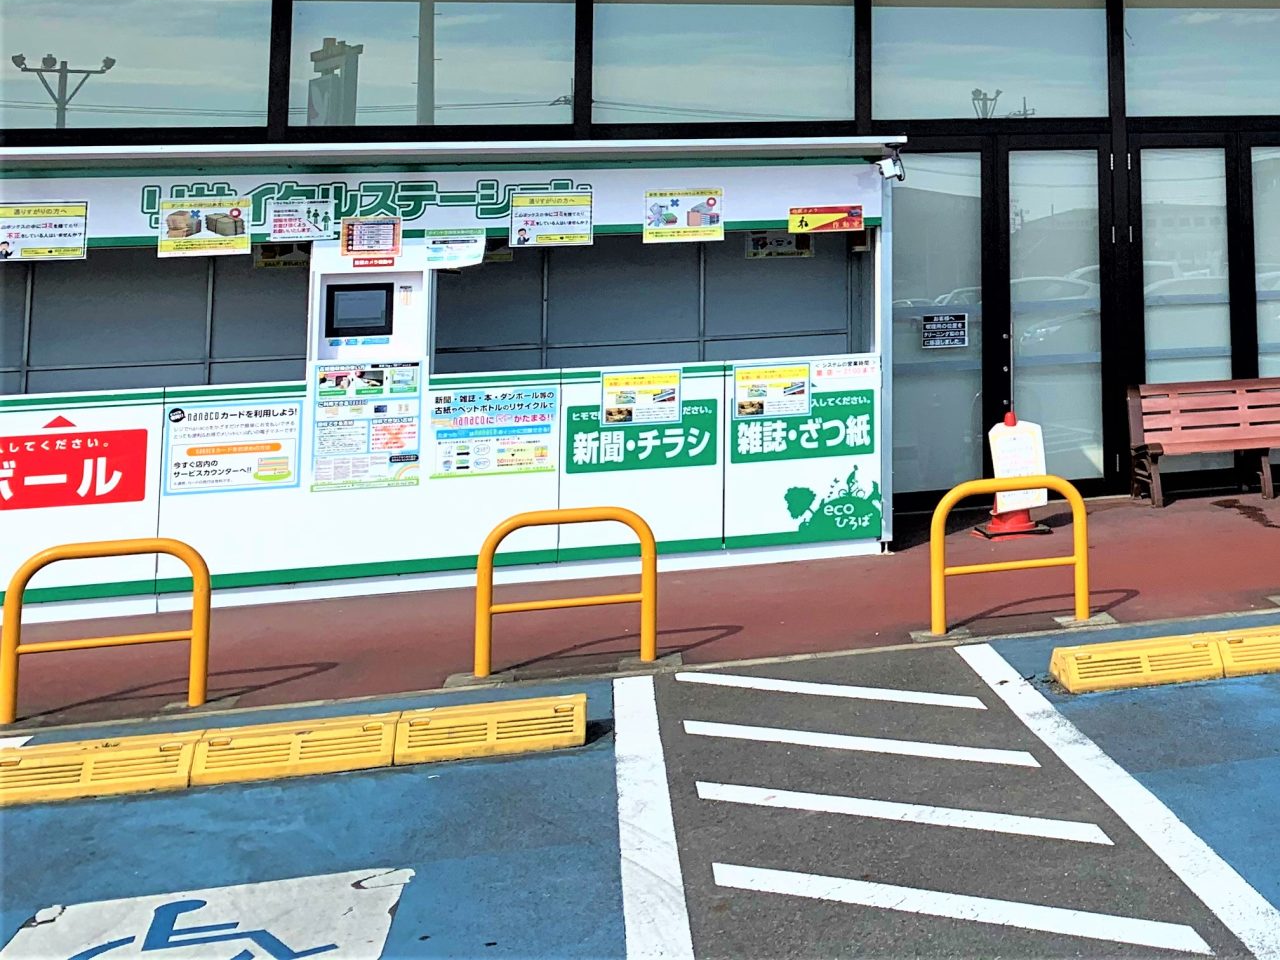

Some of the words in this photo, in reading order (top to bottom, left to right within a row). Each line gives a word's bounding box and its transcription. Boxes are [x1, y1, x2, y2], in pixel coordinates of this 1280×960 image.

[141, 179, 593, 228] リイルステーシ
[737, 413, 871, 455] 雑誌・ざつ紙
[0, 438, 109, 454] してください。
[572, 427, 711, 466] 新聞・チラシ
[173, 460, 219, 470] 今すぐ店内の
[823, 503, 855, 516] eco
[834, 512, 874, 530] ひろば
